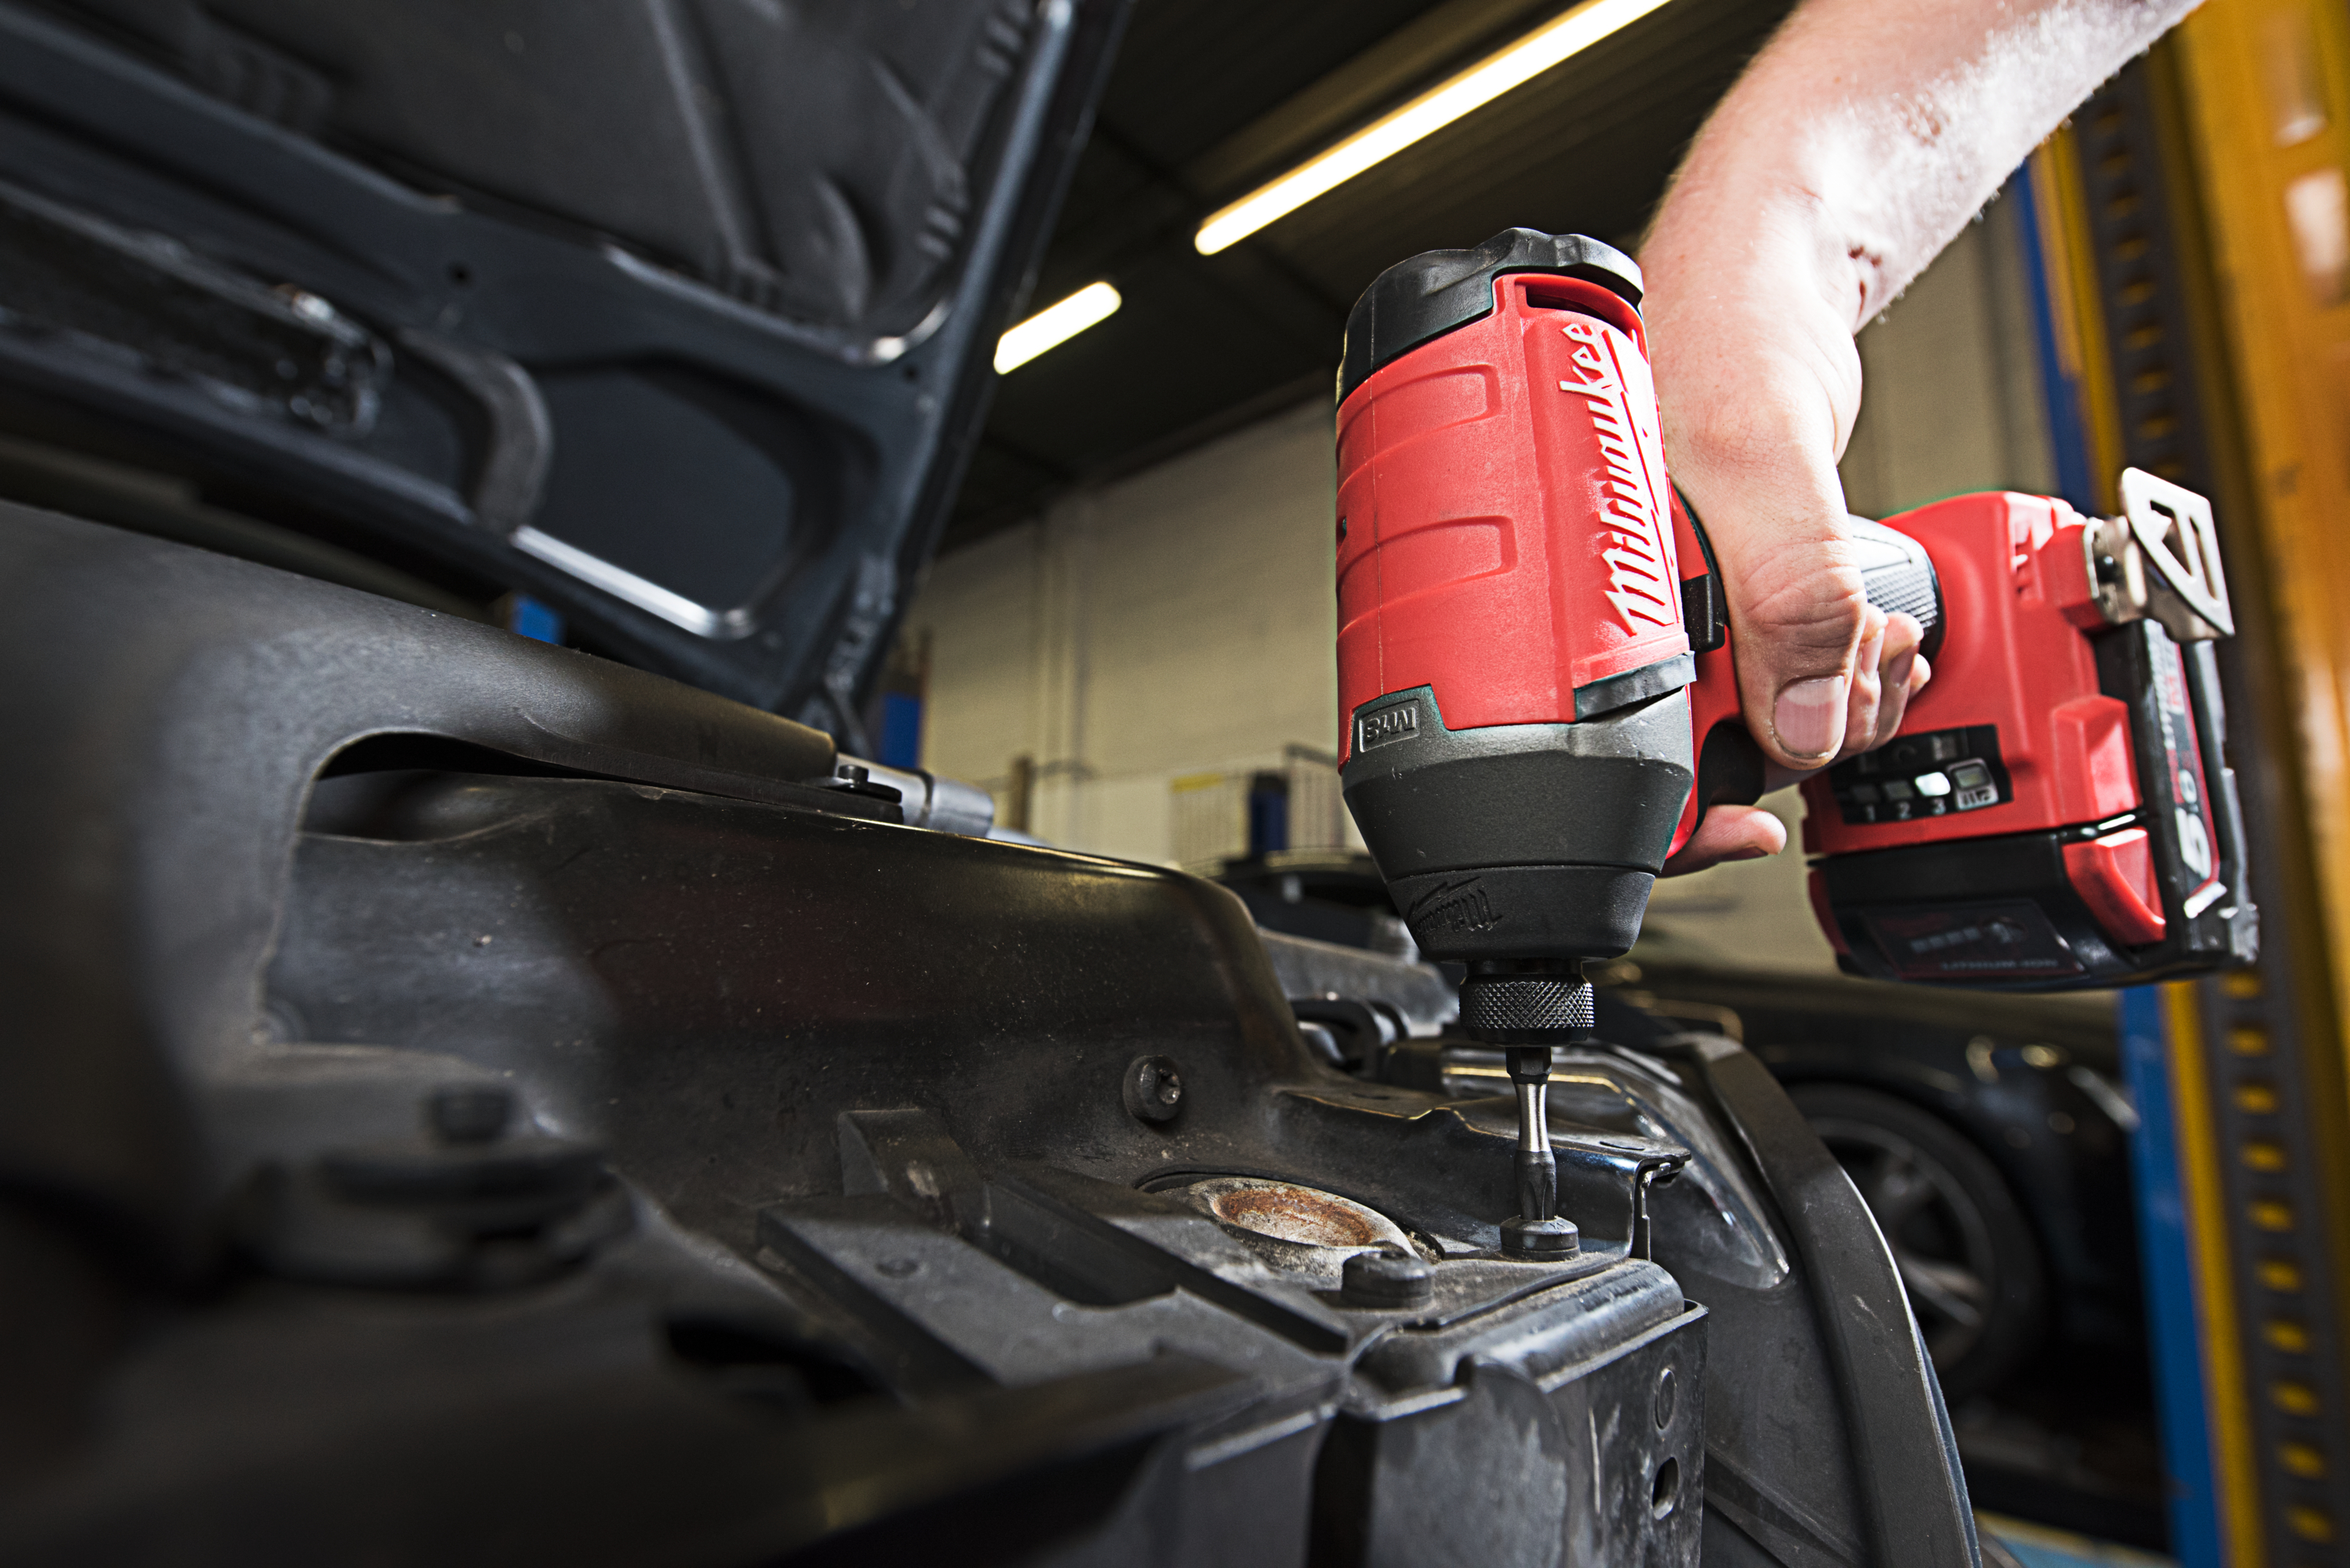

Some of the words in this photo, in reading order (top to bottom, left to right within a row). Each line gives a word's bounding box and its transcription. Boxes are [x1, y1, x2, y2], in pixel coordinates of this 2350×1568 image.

[1559, 323, 1675, 637] Milwaukee
[1364, 707, 1416, 743] M18
[1897, 801, 1912, 820] 2
[1931, 797, 1947, 815] 3
